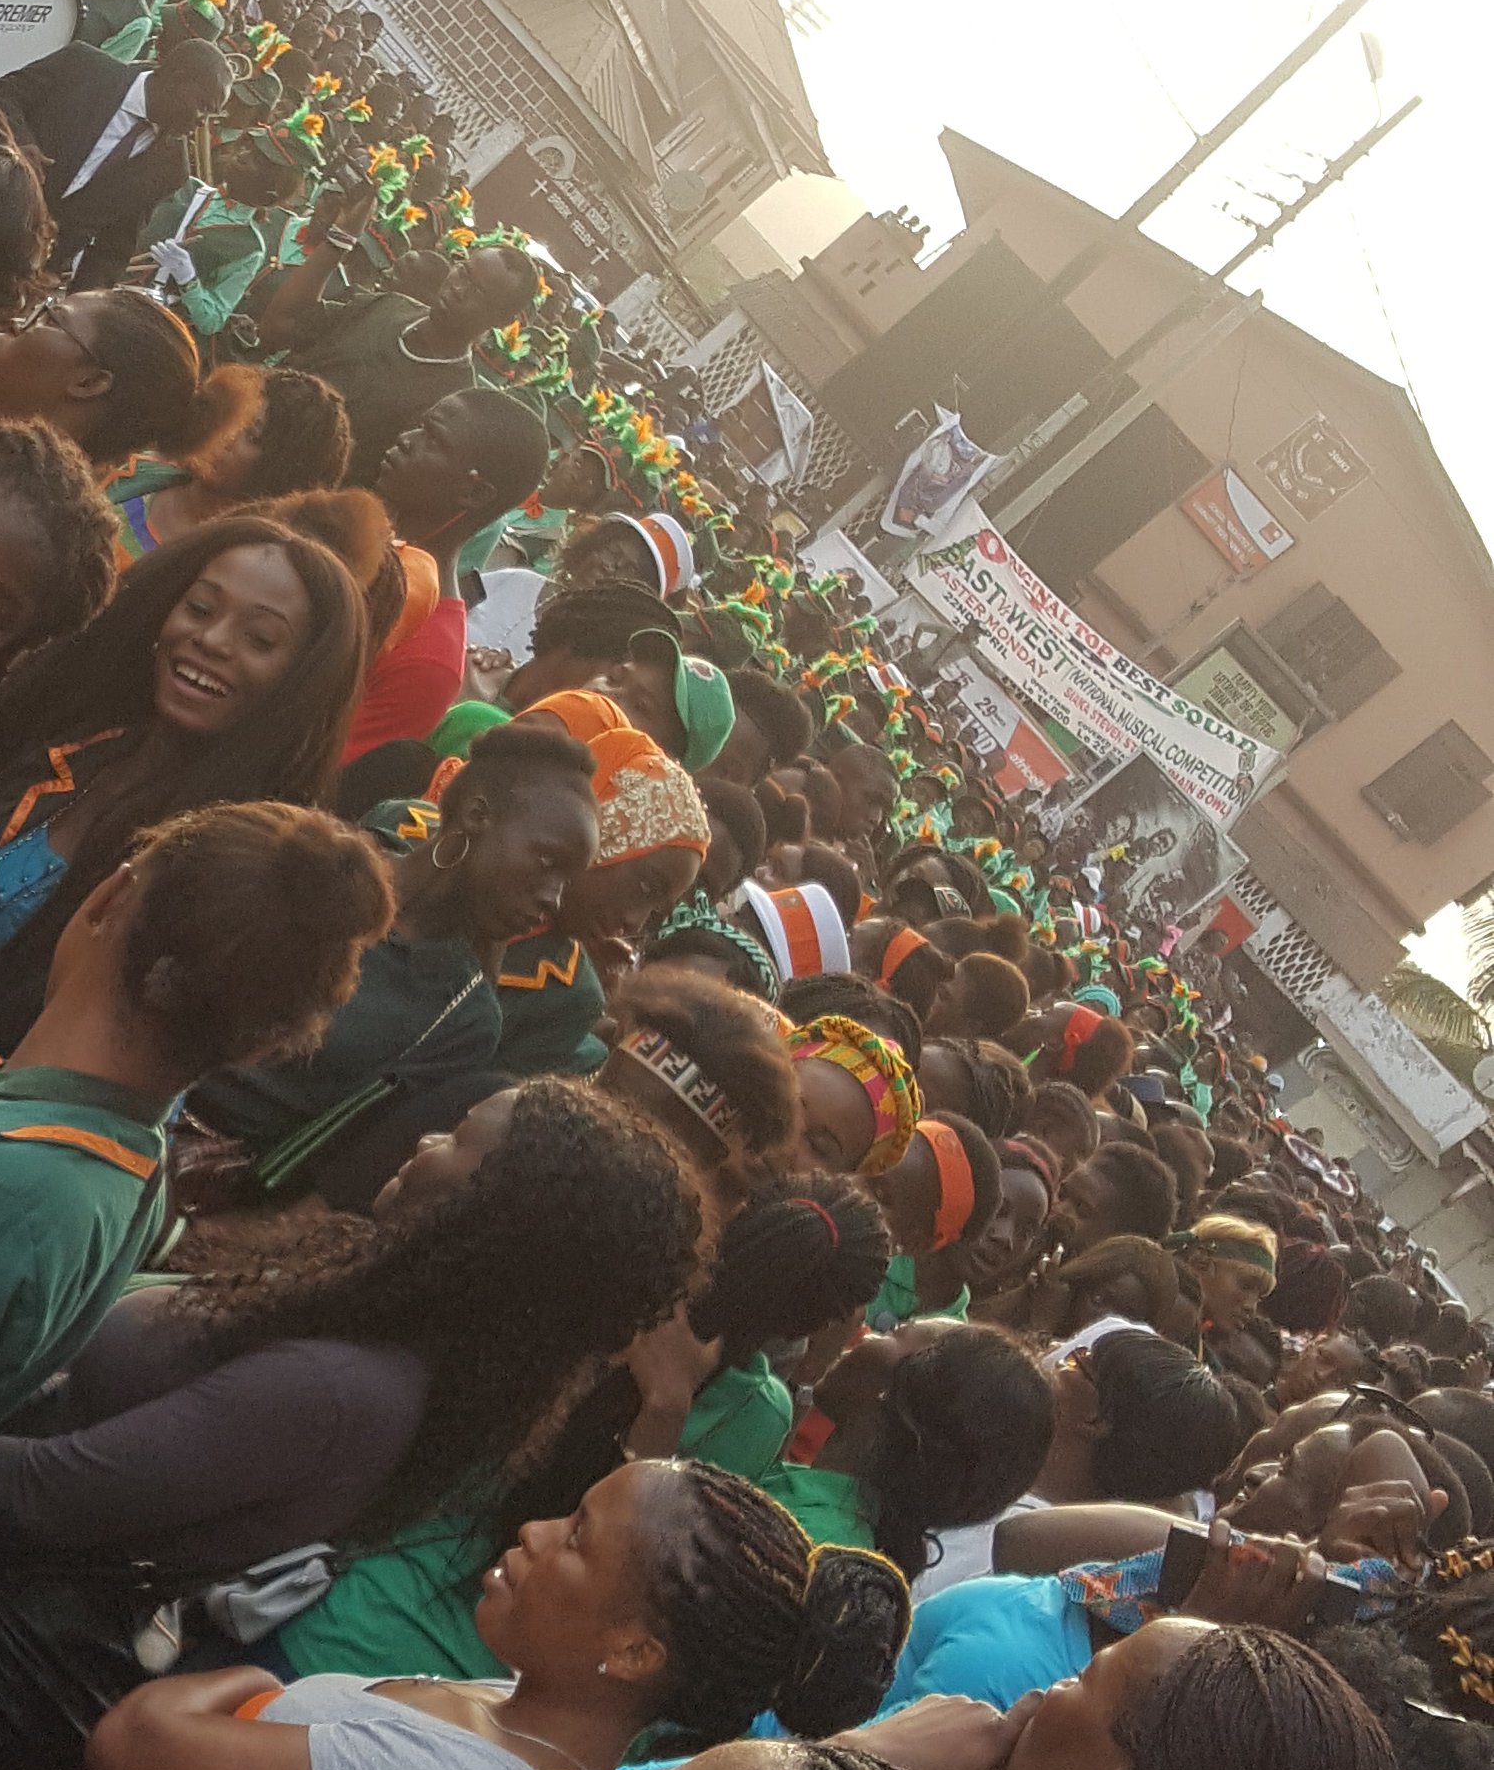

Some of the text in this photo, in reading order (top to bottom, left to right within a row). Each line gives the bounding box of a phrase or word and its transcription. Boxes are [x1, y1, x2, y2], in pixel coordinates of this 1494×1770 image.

[930, 561, 986, 617] EASTER
[985, 615, 1048, 677] MONDAY
[942, 592, 973, 622] 22ND
[941, 543, 1007, 605] EAST
[1005, 602, 1073, 672] WEST
[1115, 710, 1166, 754] MUSICAL
[1166, 745, 1249, 806] COMPETITION
[974, 696, 998, 718] 29
[1072, 620, 1114, 658] TOP
[1112, 655, 1171, 703] BEST
[1170, 698, 1258, 752] SQUAD
